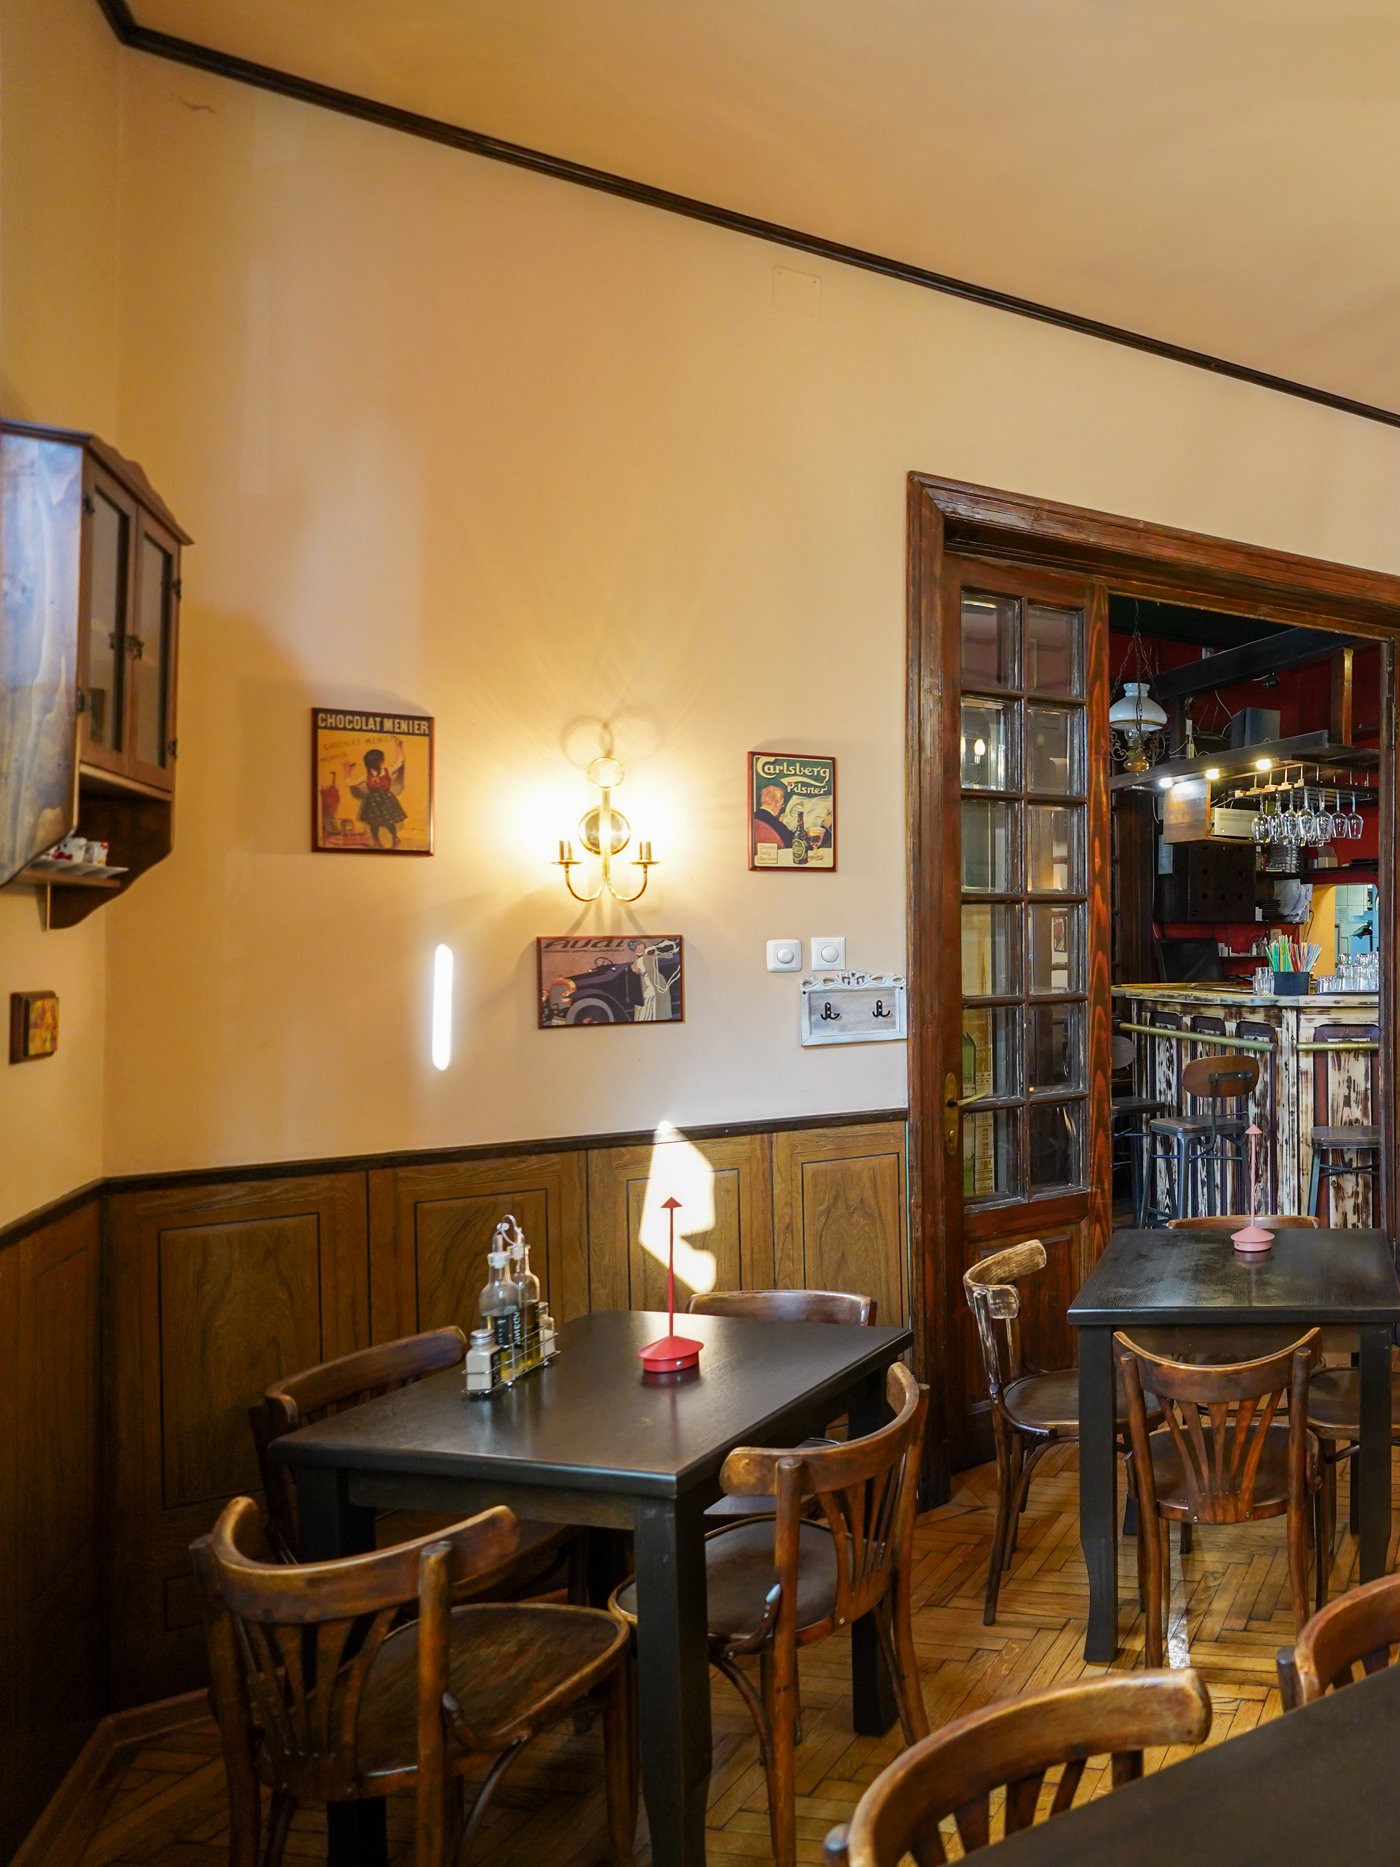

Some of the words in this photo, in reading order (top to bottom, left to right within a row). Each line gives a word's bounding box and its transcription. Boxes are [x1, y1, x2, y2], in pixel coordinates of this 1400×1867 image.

[317, 713, 382, 731] CHOCOLAT
[383, 717, 429, 735] MENIER
[757, 756, 830, 783] Carlsberg
[787, 782, 828, 795] Pilsner
